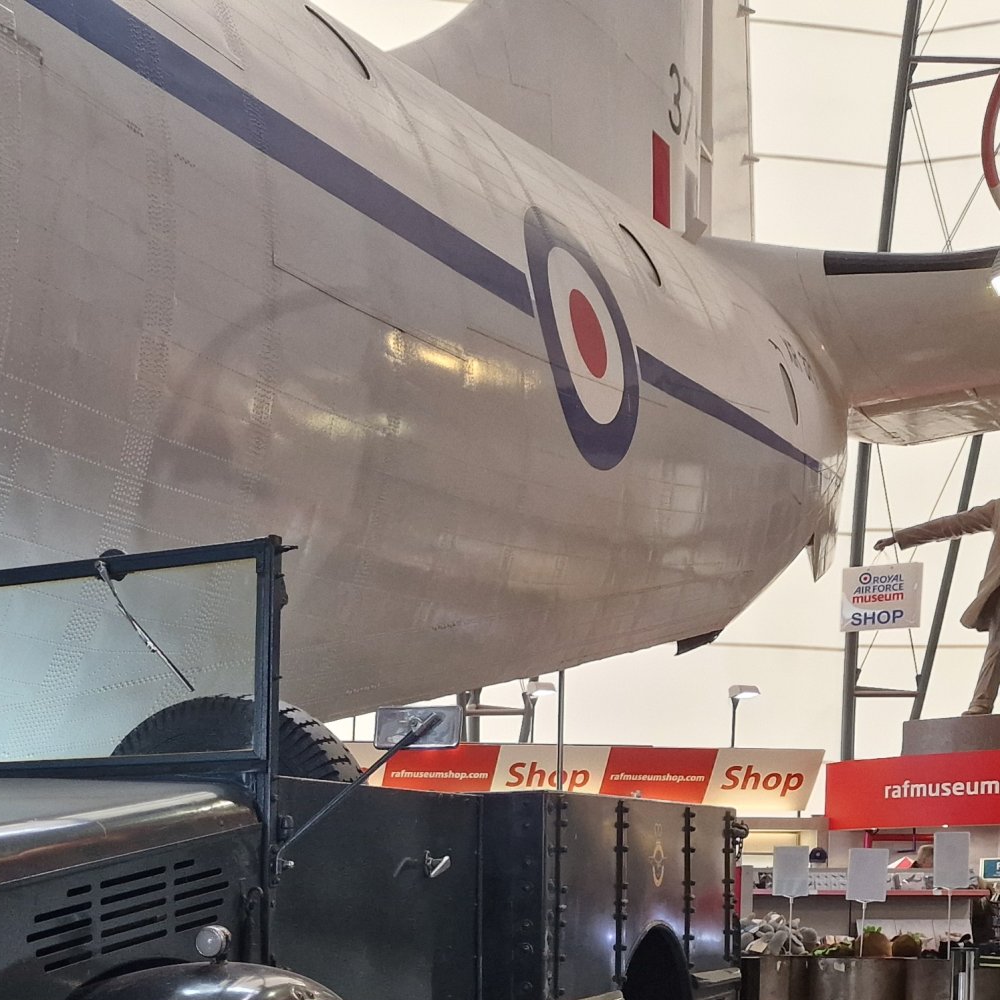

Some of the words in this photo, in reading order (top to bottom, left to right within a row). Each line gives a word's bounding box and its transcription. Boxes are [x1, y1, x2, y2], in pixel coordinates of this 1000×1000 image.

[872, 573, 904, 584] ROYAL
[853, 586, 871, 595] AIR
[872, 583, 904, 594] FORCE
[852, 592, 904, 605] museum
[851, 609, 904, 626] SHOP
[391, 769, 489, 780] rafmuseumshop.com
[505, 761, 590, 792] Shop
[610, 772, 705, 783] rafmuseumshop.com
[720, 765, 804, 797] Shop
[884, 780, 1000, 799] rafmuseum
